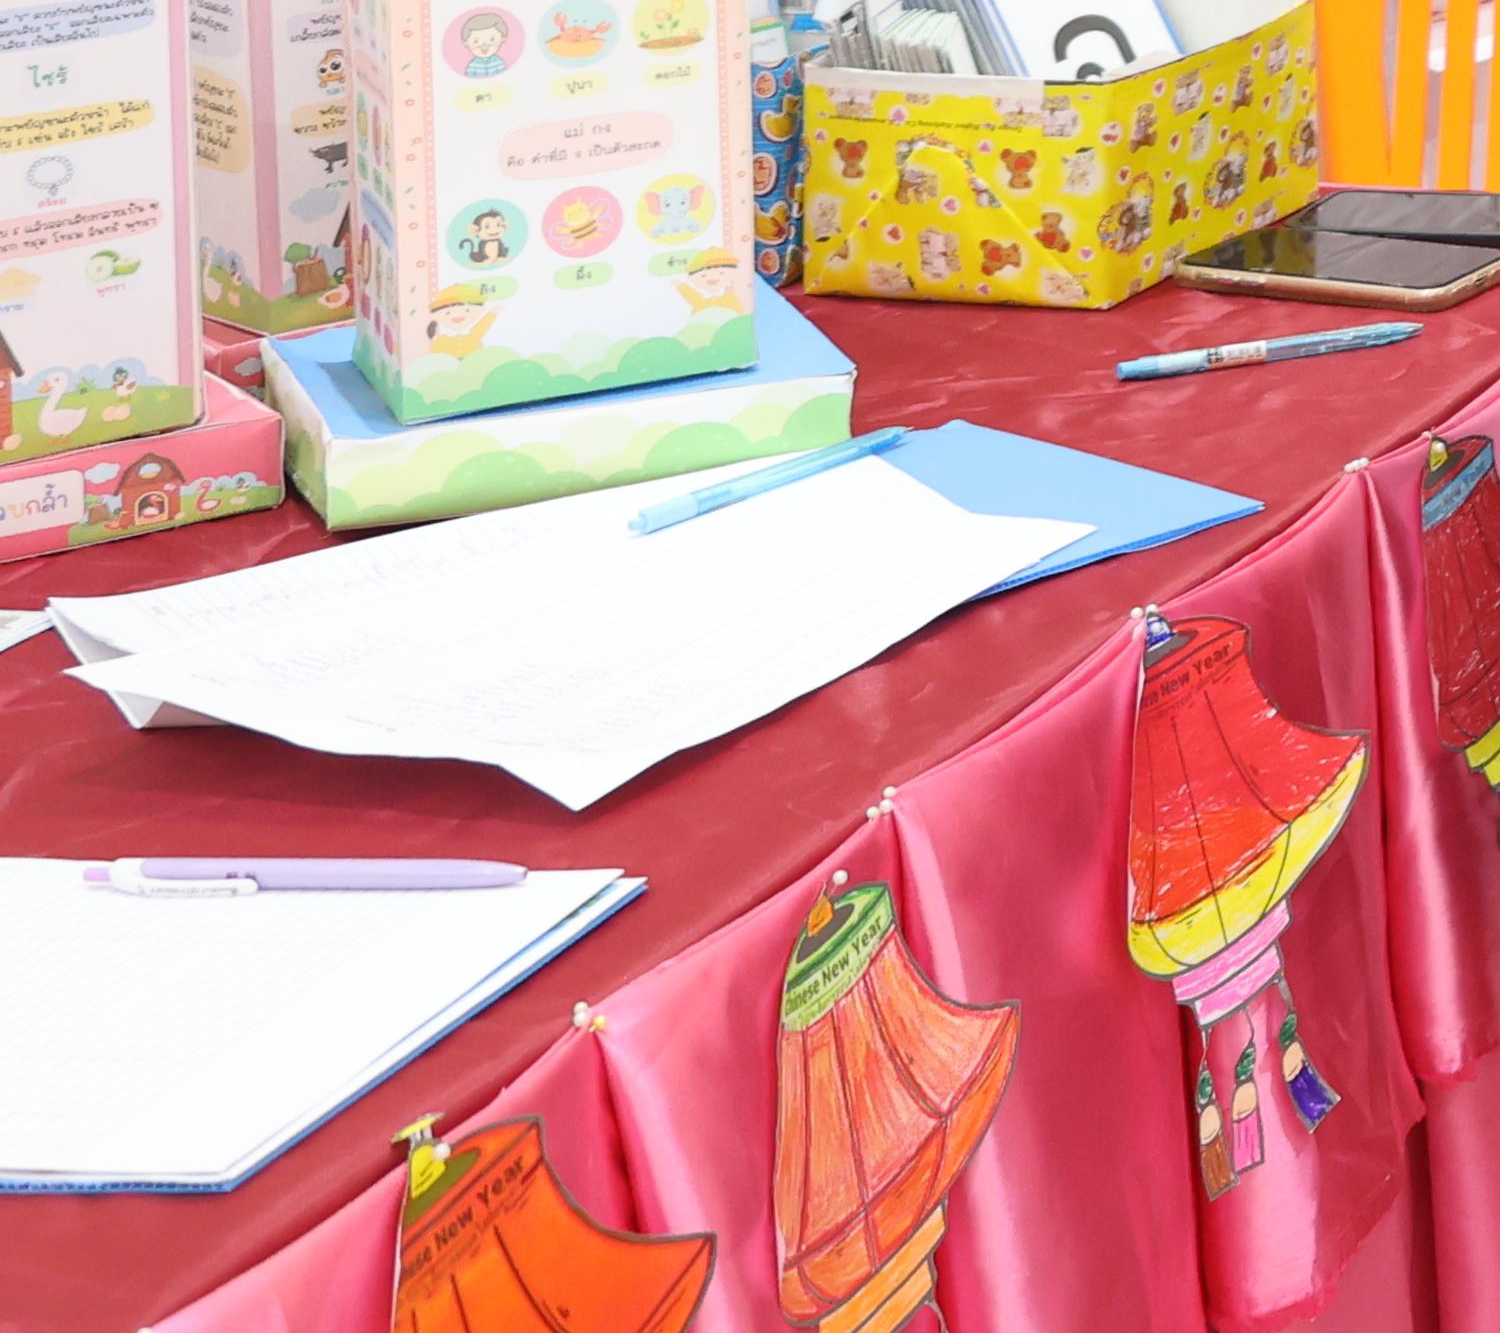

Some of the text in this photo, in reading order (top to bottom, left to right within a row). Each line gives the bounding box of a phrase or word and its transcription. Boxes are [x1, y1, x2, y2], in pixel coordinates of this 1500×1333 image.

[1161, 643, 1231, 698] New Year
[821, 915, 884, 986] New Year
[431, 1154, 526, 1251] New Year
